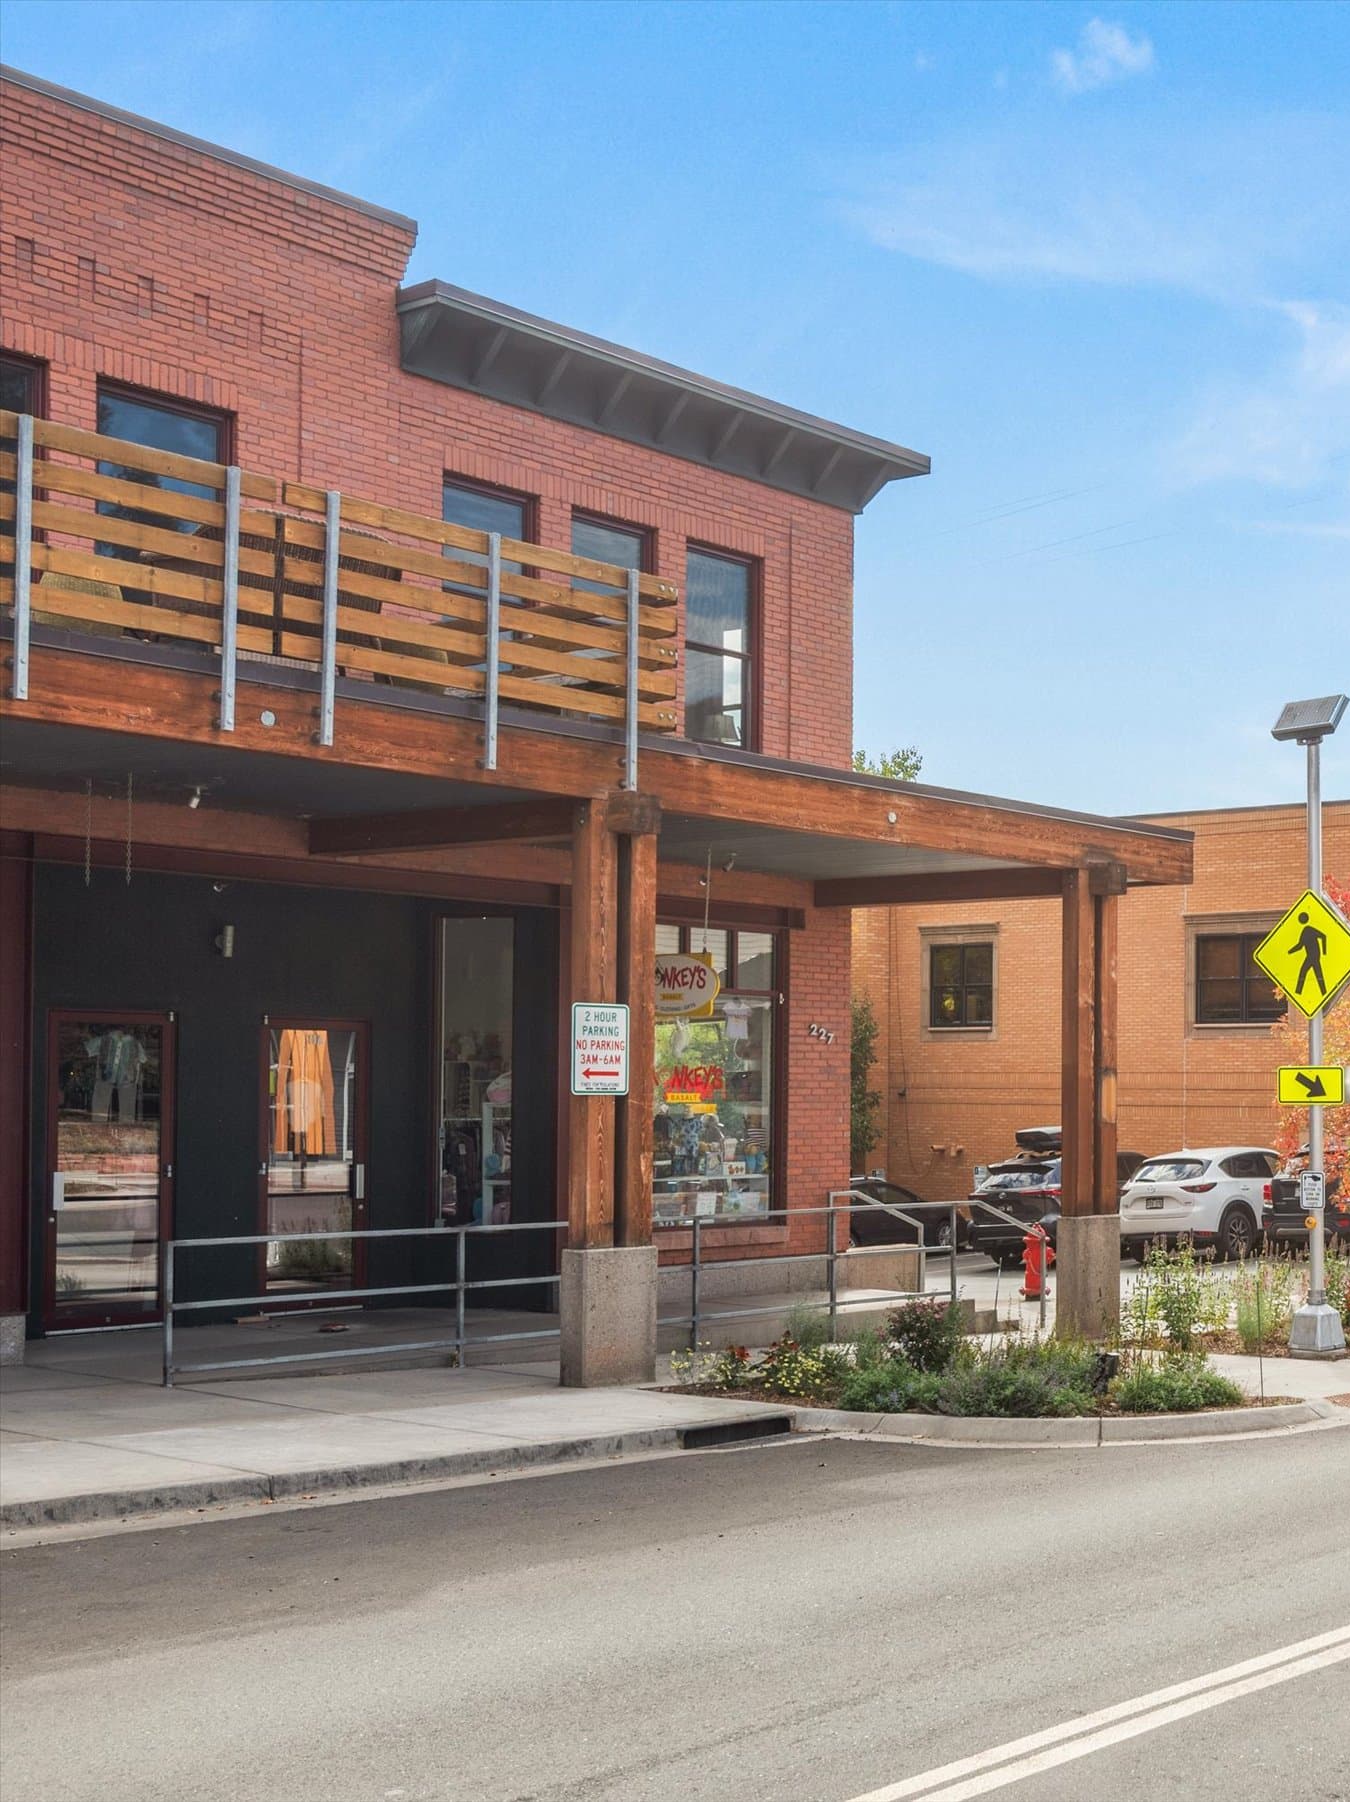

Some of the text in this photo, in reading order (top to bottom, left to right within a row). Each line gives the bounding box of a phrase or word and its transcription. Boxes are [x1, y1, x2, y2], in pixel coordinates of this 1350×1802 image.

[585, 1011, 617, 1022] 2 HOUR
[582, 1026, 619, 1037] PARKING
[809, 1023, 834, 1045] 227
[576, 1040, 625, 1051] NO PARKING
[580, 1054, 621, 1065] 3AM-6AM
